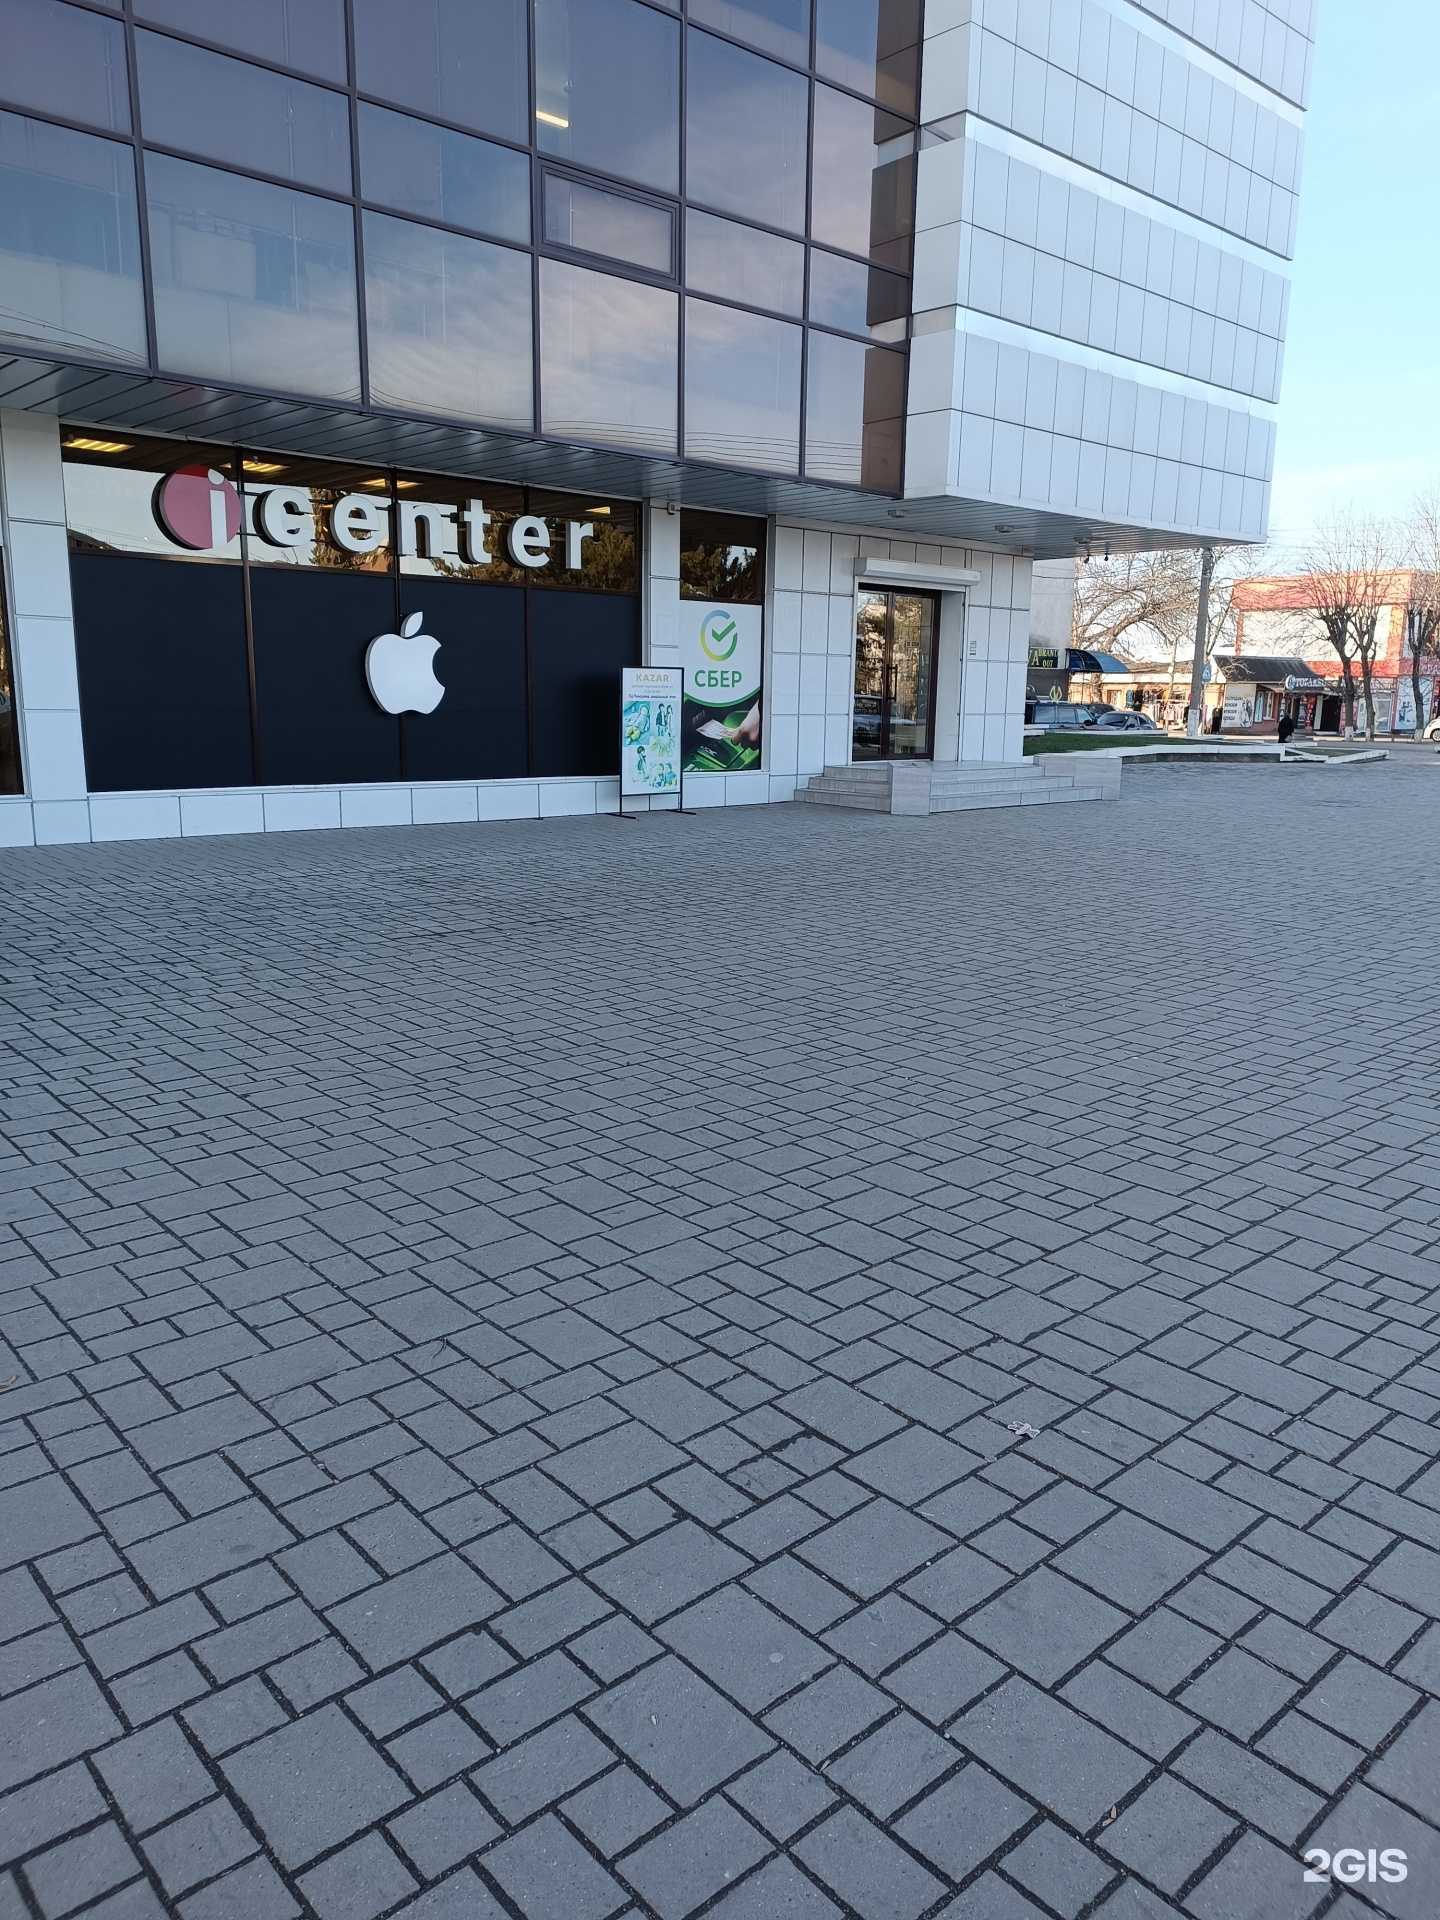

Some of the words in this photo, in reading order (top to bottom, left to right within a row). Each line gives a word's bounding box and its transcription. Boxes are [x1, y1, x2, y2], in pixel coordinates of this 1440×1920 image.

[206, 468, 595, 570] icenter
[635, 673, 670, 682] KAZAR
[694, 669, 742, 688] СБЕР
